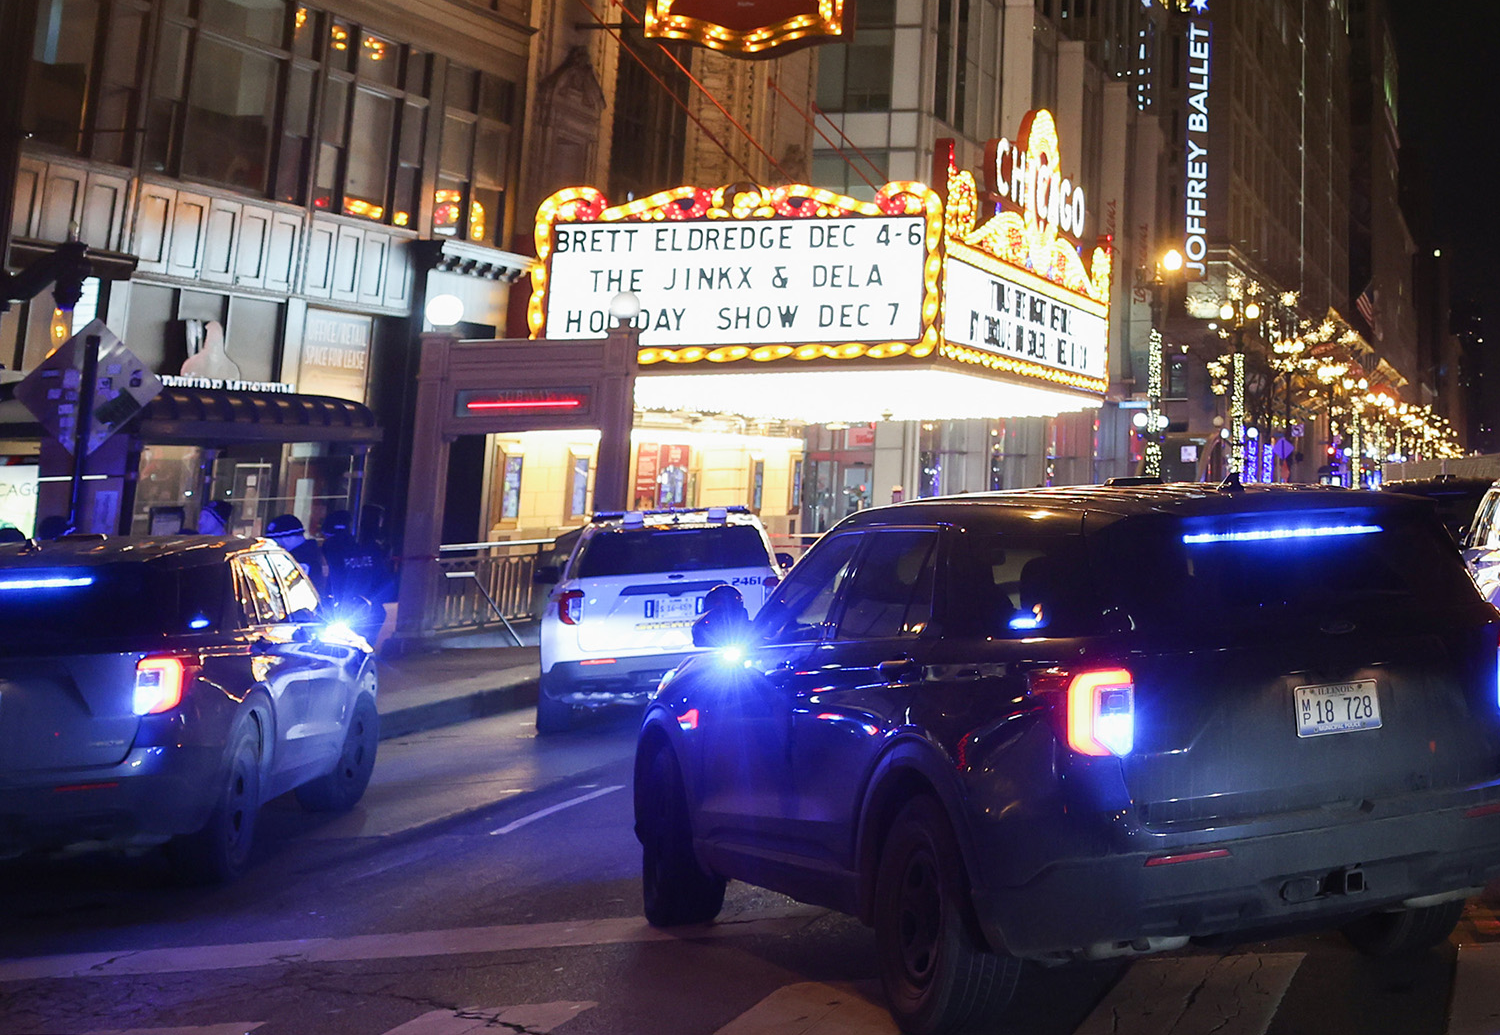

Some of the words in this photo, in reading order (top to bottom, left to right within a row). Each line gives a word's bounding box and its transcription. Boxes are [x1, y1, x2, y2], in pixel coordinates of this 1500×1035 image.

[1188, 22, 1209, 133] BALLET
[1185, 140, 1207, 276] JOFFREY
[556, 229, 638, 253] BRETT
[654, 225, 794, 253] ELDREDGE
[809, 224, 856, 249] DEC
[876, 222, 922, 247] 4-6
[589, 268, 644, 293] THE
[663, 266, 753, 291] JINKX
[771, 266, 788, 289] &
[812, 264, 884, 288] DELA
[565, 307, 687, 334] HOLDAY
[716, 304, 799, 330] SHOW
[818, 303, 871, 328] DEC
[888, 302, 901, 326] 7
[732, 576, 761, 586] 2461
[1317, 685, 1355, 696] ILLINOIS
[1316, 699, 1335, 724] 18
[1343, 695, 1373, 720] 728
